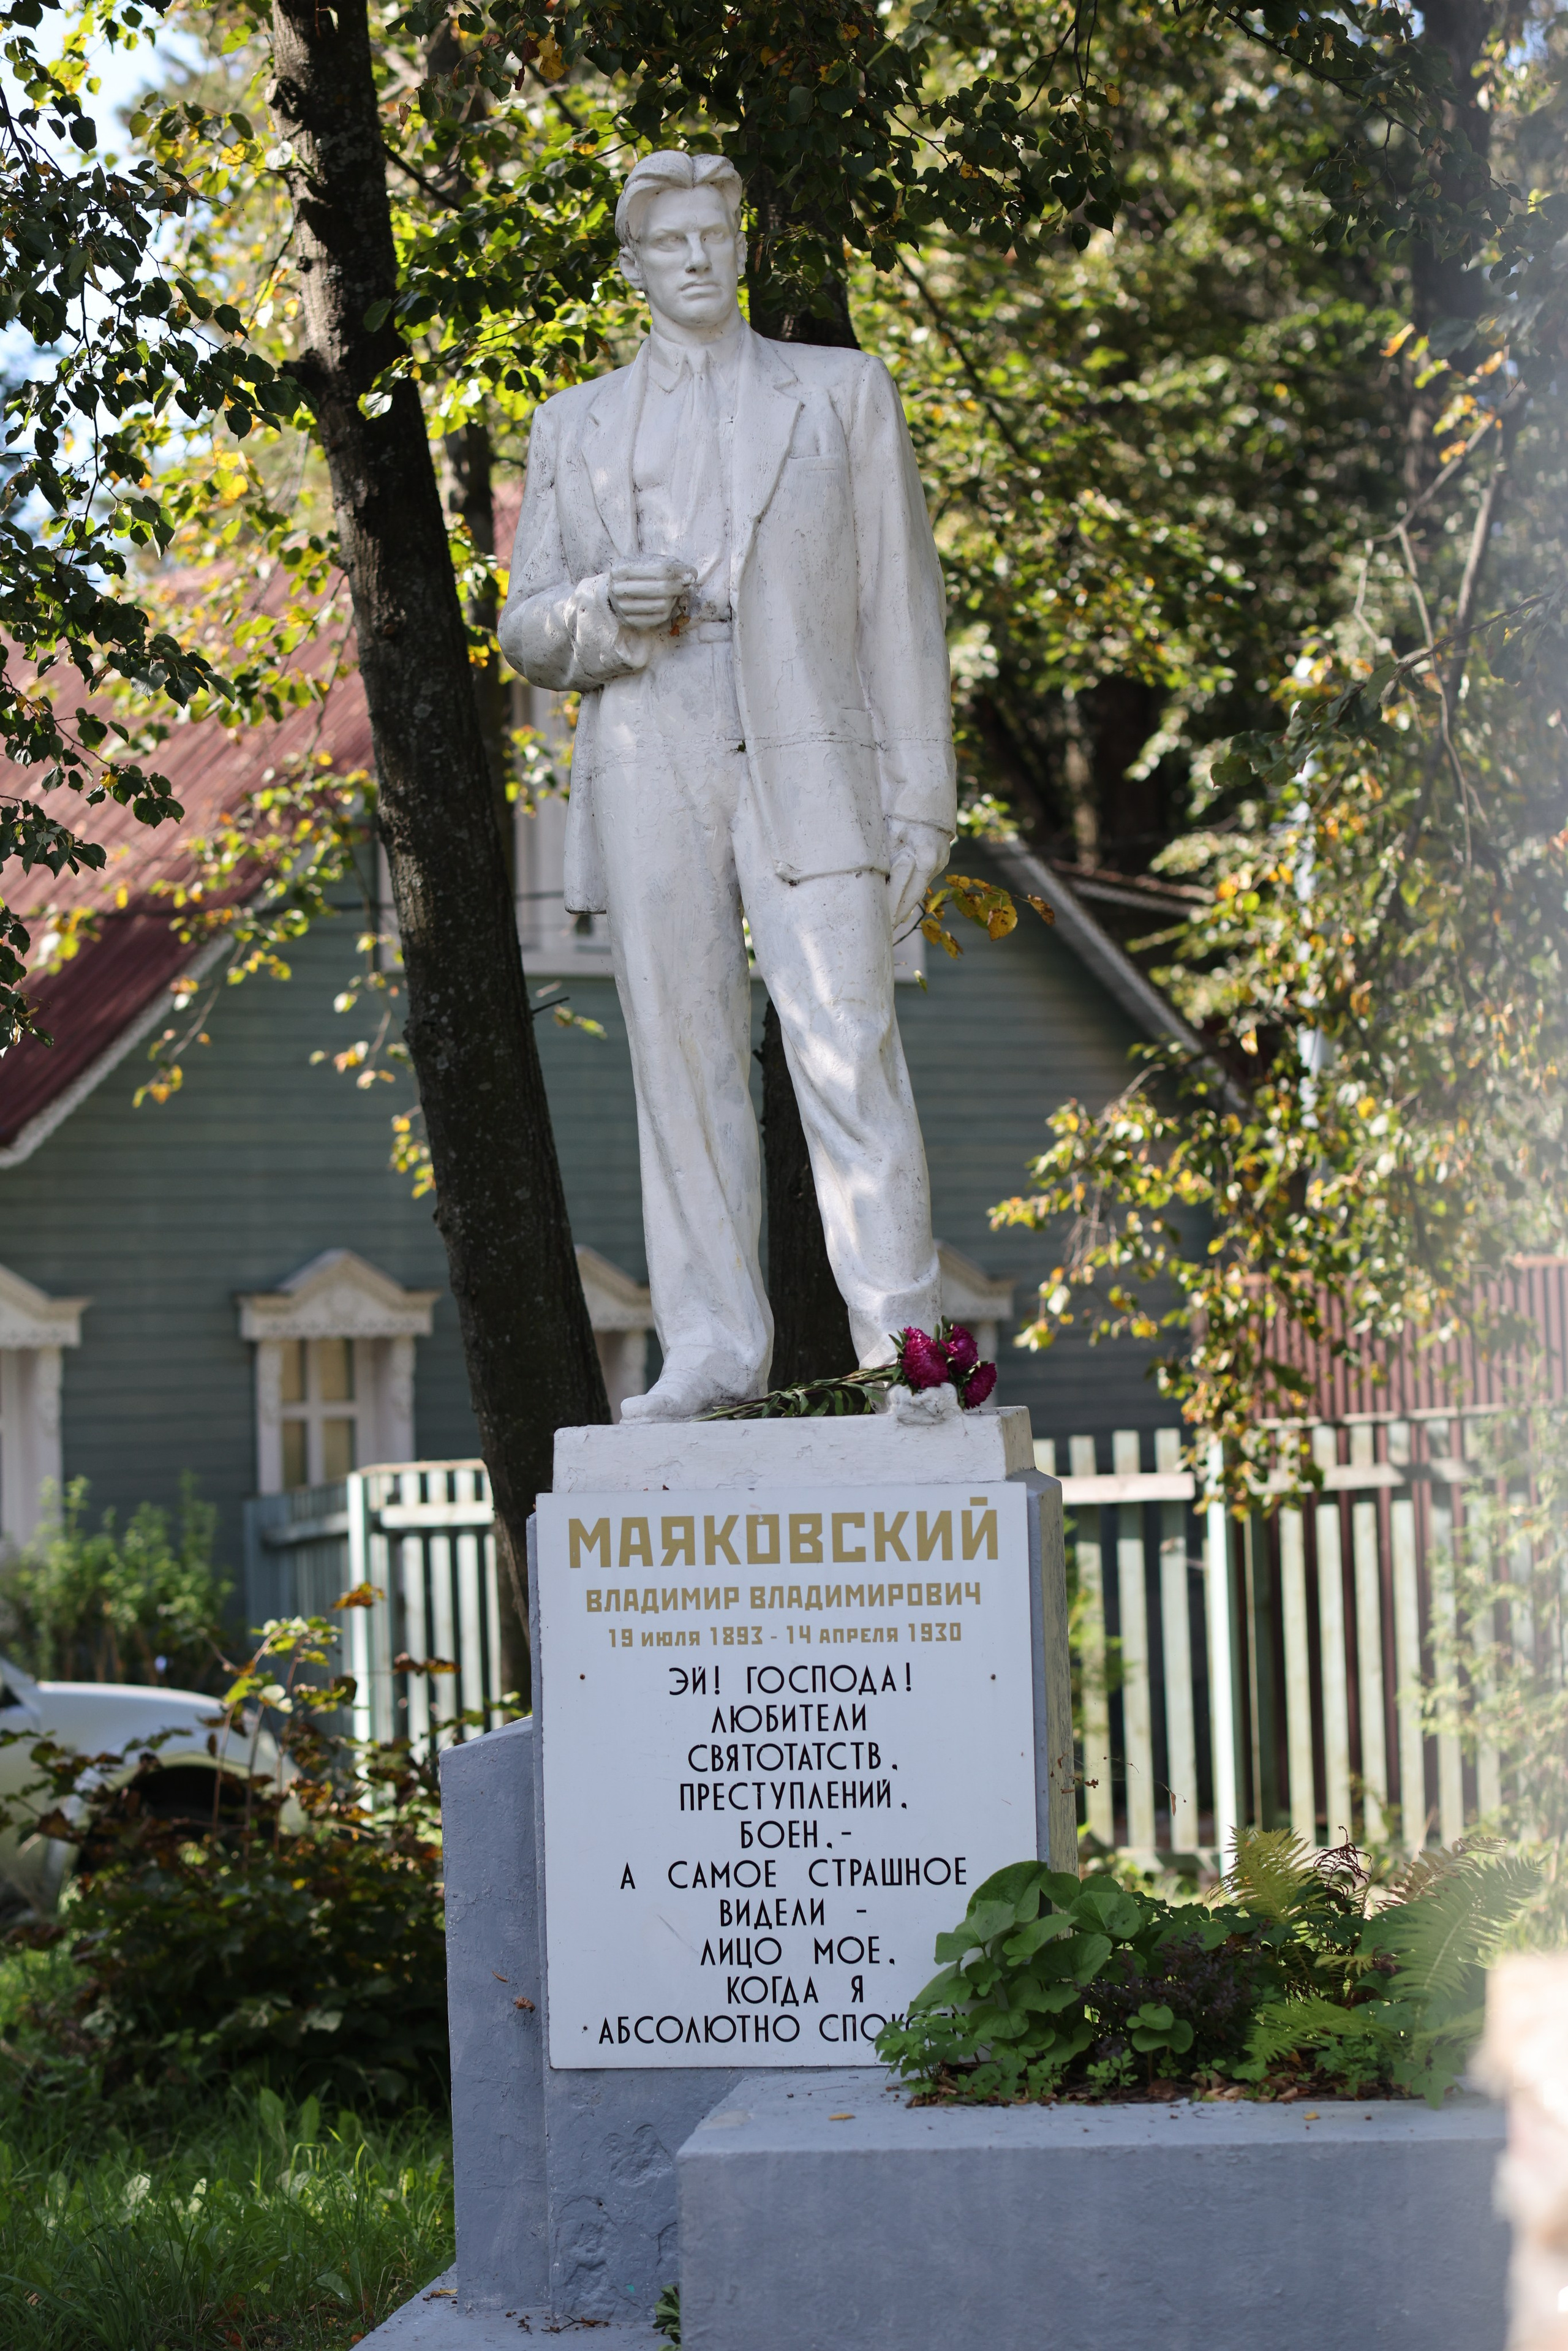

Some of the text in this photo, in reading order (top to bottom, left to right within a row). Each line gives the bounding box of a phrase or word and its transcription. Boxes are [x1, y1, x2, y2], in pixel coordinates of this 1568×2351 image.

[569, 1497, 998, 1568] МАЯКОВСКИЙ
[587, 1583, 981, 1613] ВЛАДИМИР ВЛАДИМИРОВИЧ
[609, 1629, 632, 1647] 19
[641, 1631, 700, 1647] ИЮЛЯ
[710, 1626, 763, 1645] 1893
[786, 1625, 811, 1643] 14
[820, 1628, 898, 1643] АПРЕЛЯ
[908, 1623, 961, 1642] 1930
[669, 1662, 911, 1696] ЭЙ! ГОСПОДА!
[712, 1704, 866, 1733] ЛЮБИТЕЛИ
[620, 1857, 967, 1890] А САМОЕ СТРАШНОЕ
[720, 1898, 824, 1930] ВИДЕЛИ
[701, 1938, 782, 1968] ЛИЦО
[728, 1976, 864, 2007] КОГДА Я
[599, 2014, 801, 2045] АБСОЛЮТНО
